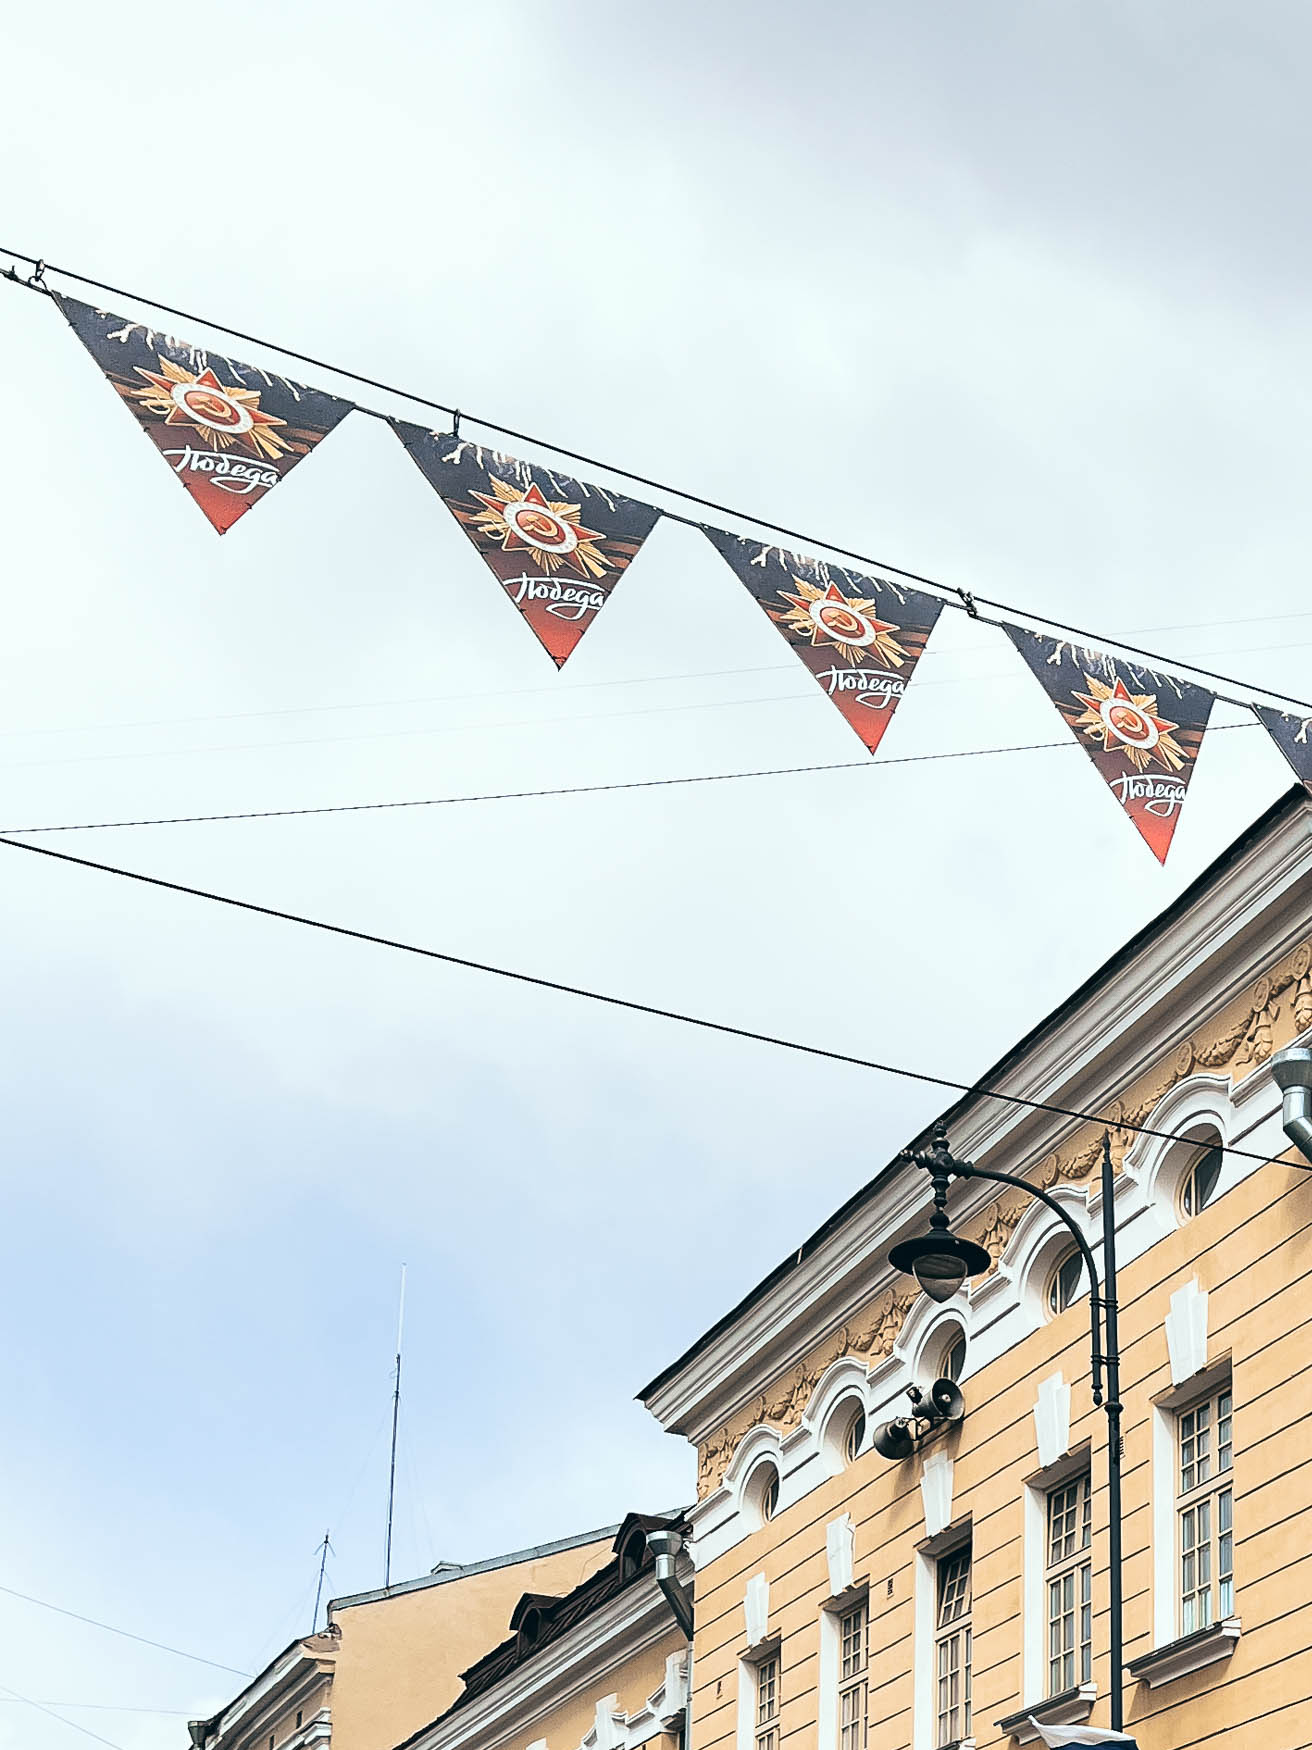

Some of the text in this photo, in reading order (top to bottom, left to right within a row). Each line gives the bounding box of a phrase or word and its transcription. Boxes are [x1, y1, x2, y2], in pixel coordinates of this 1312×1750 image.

[163, 445, 279, 494] Победа
[503, 572, 606, 620] Победа
[816, 665, 905, 709] Победа
[1110, 771, 1187, 816] Победа
